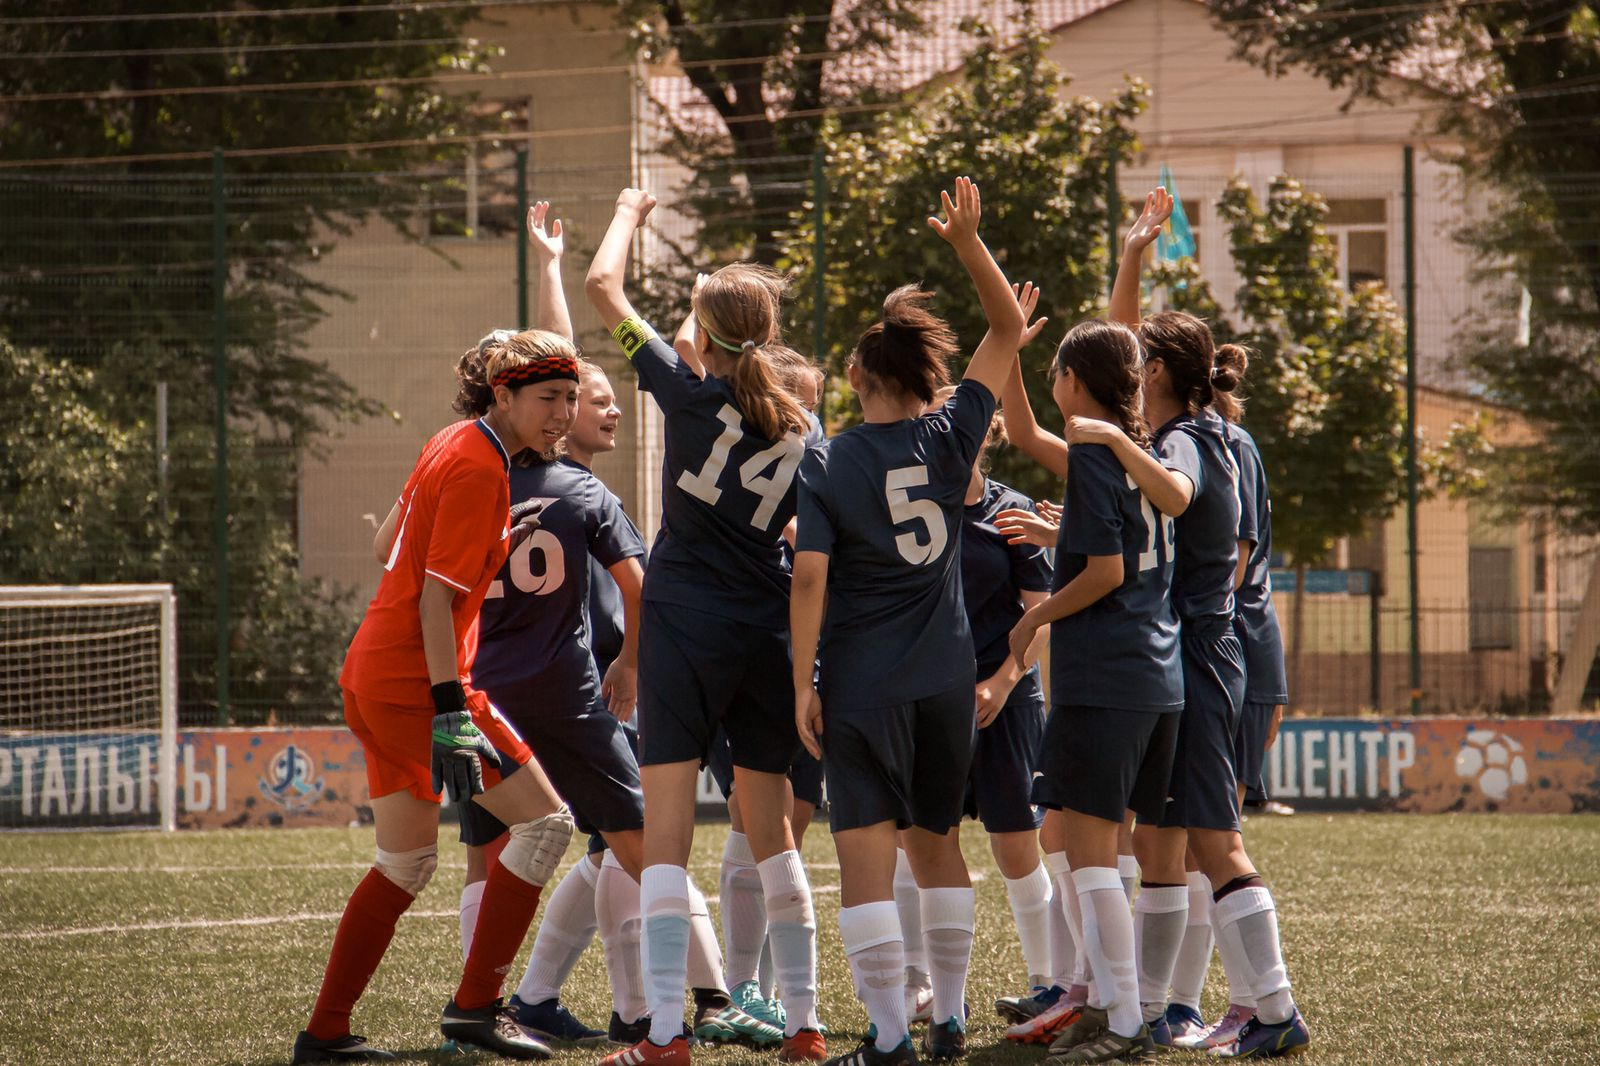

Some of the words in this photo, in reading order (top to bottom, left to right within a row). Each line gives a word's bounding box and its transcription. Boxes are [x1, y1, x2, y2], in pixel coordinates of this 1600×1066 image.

[676, 403, 806, 532] 14
[885, 465, 949, 566] 5
[484, 497, 565, 598] 6
[1269, 730, 1416, 798] ЦЕНТР
